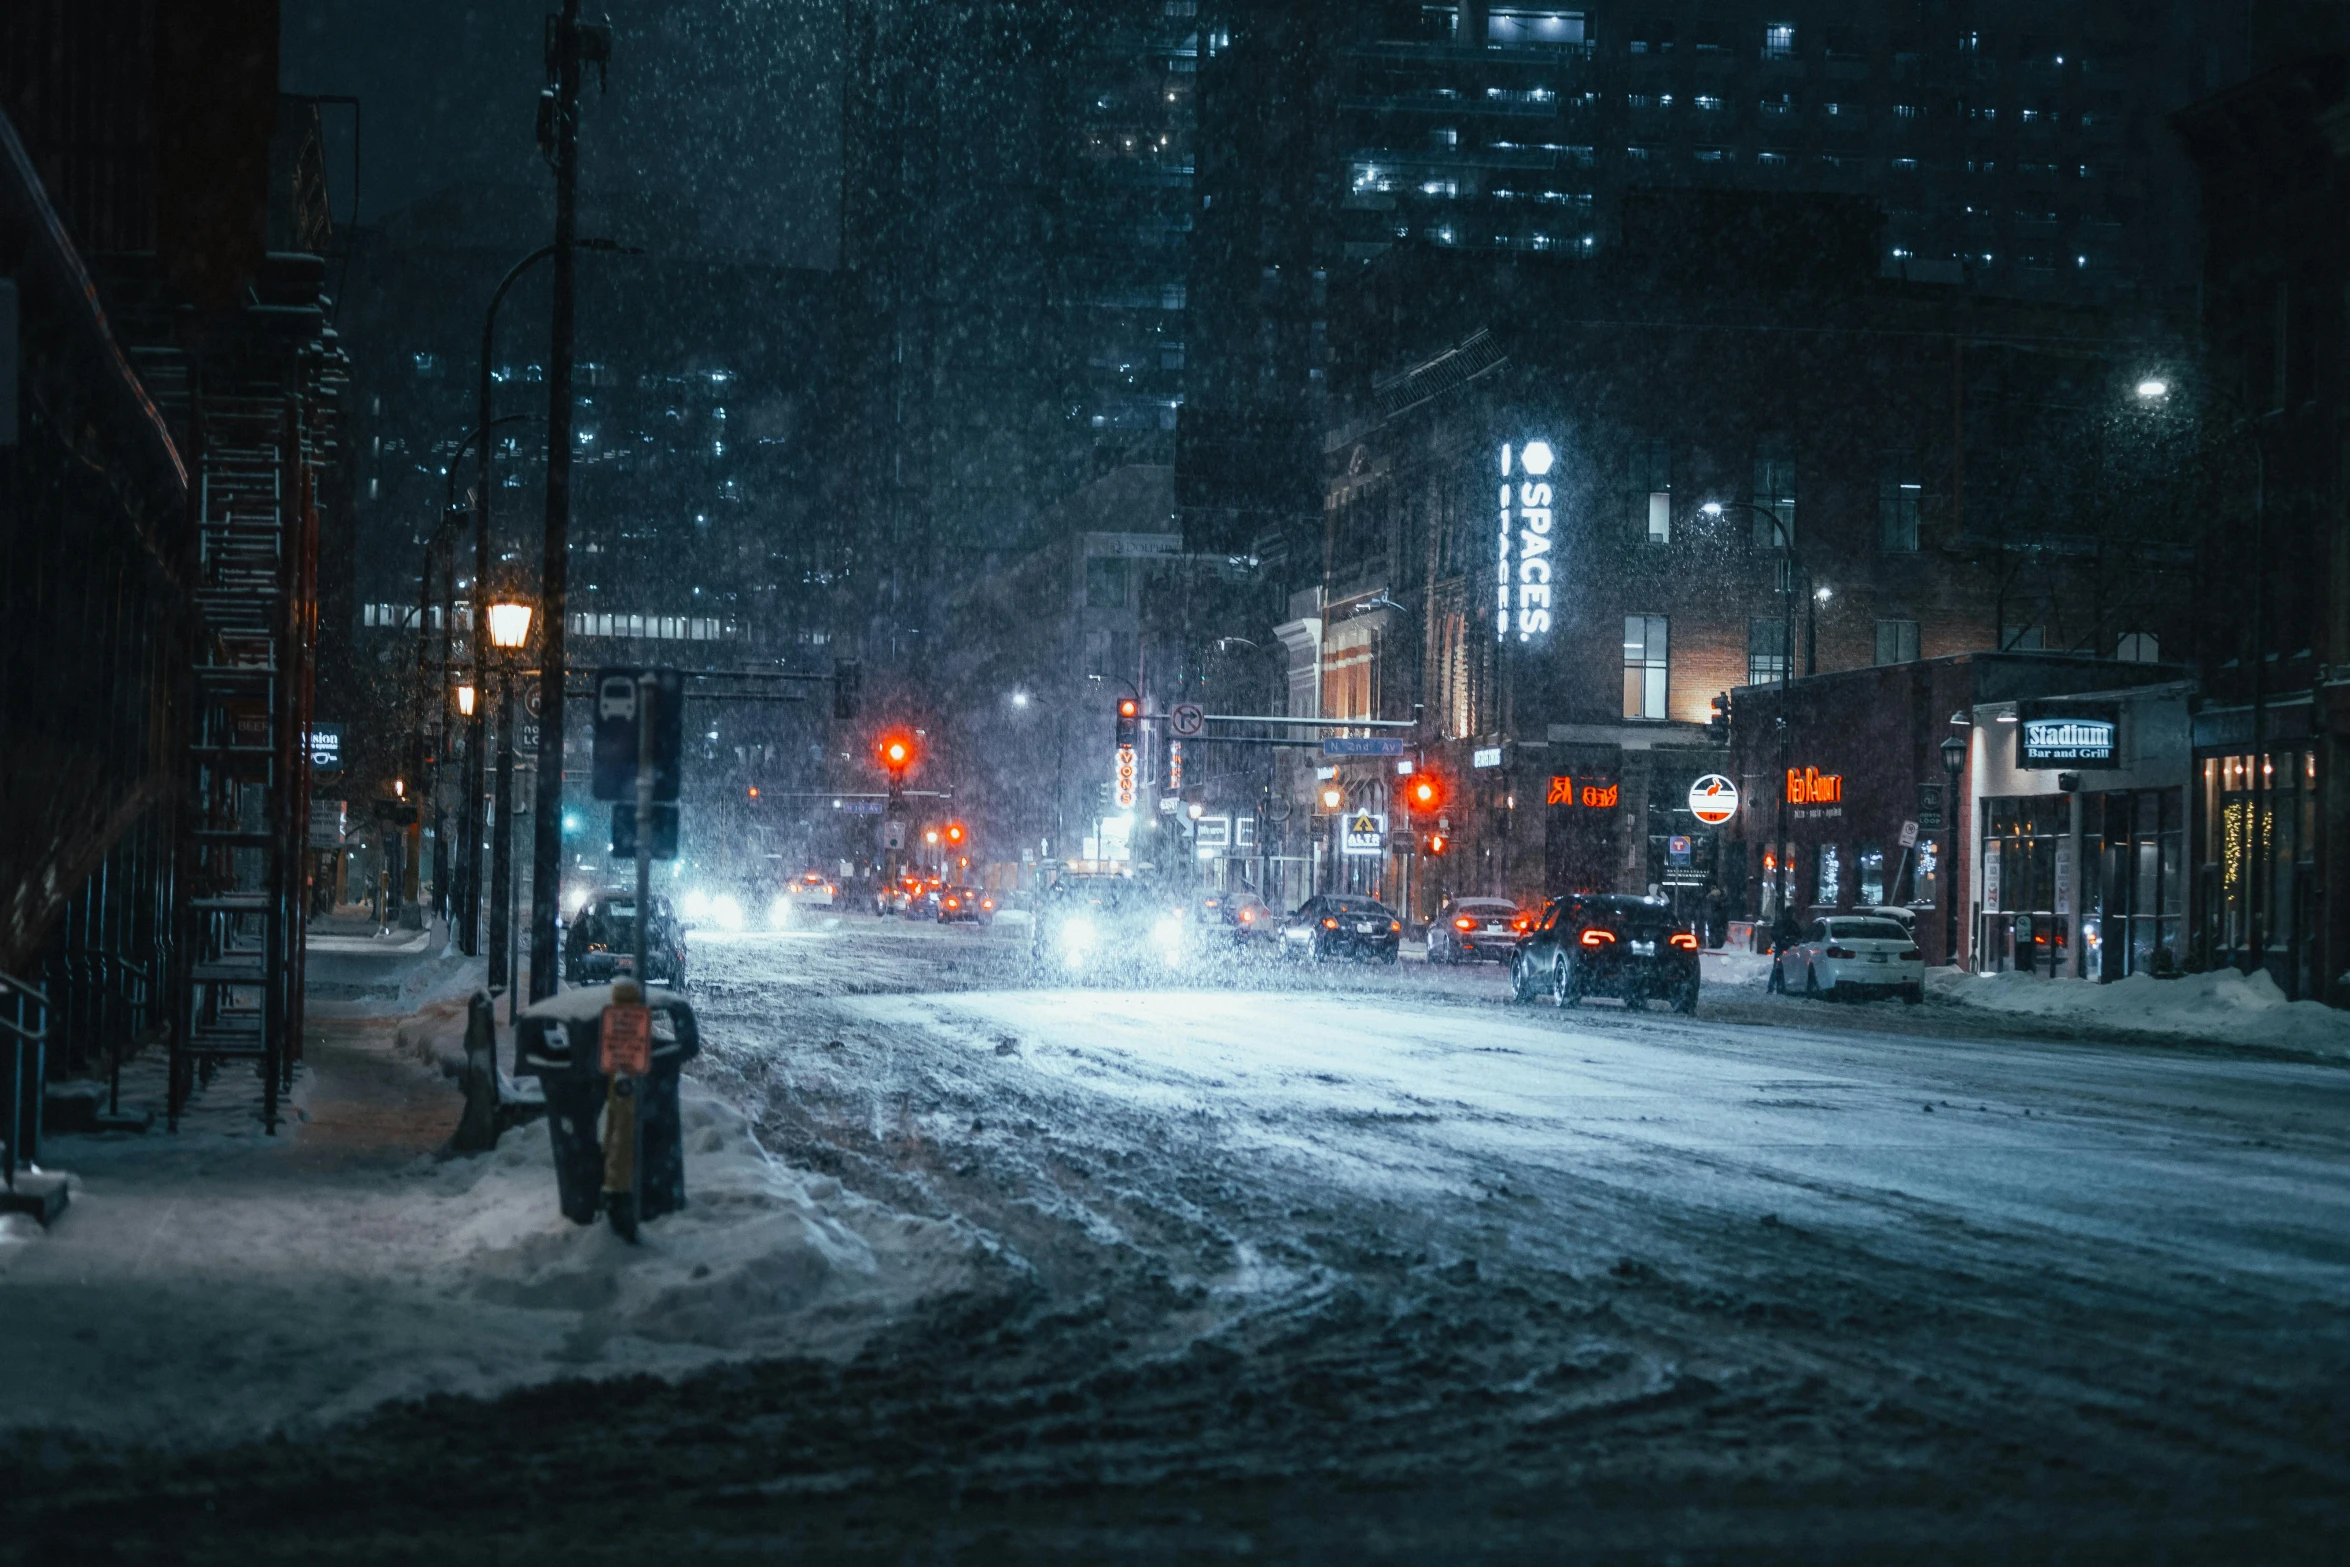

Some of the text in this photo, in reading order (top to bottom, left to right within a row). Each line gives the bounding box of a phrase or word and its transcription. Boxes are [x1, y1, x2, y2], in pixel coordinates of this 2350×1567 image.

[2029, 724, 2109, 746] Stadium
[1330, 742, 1396, 751] N 2nd Av
[2028, 748, 2110, 759] Bar and Grill
[1787, 767, 1805, 803] RED
